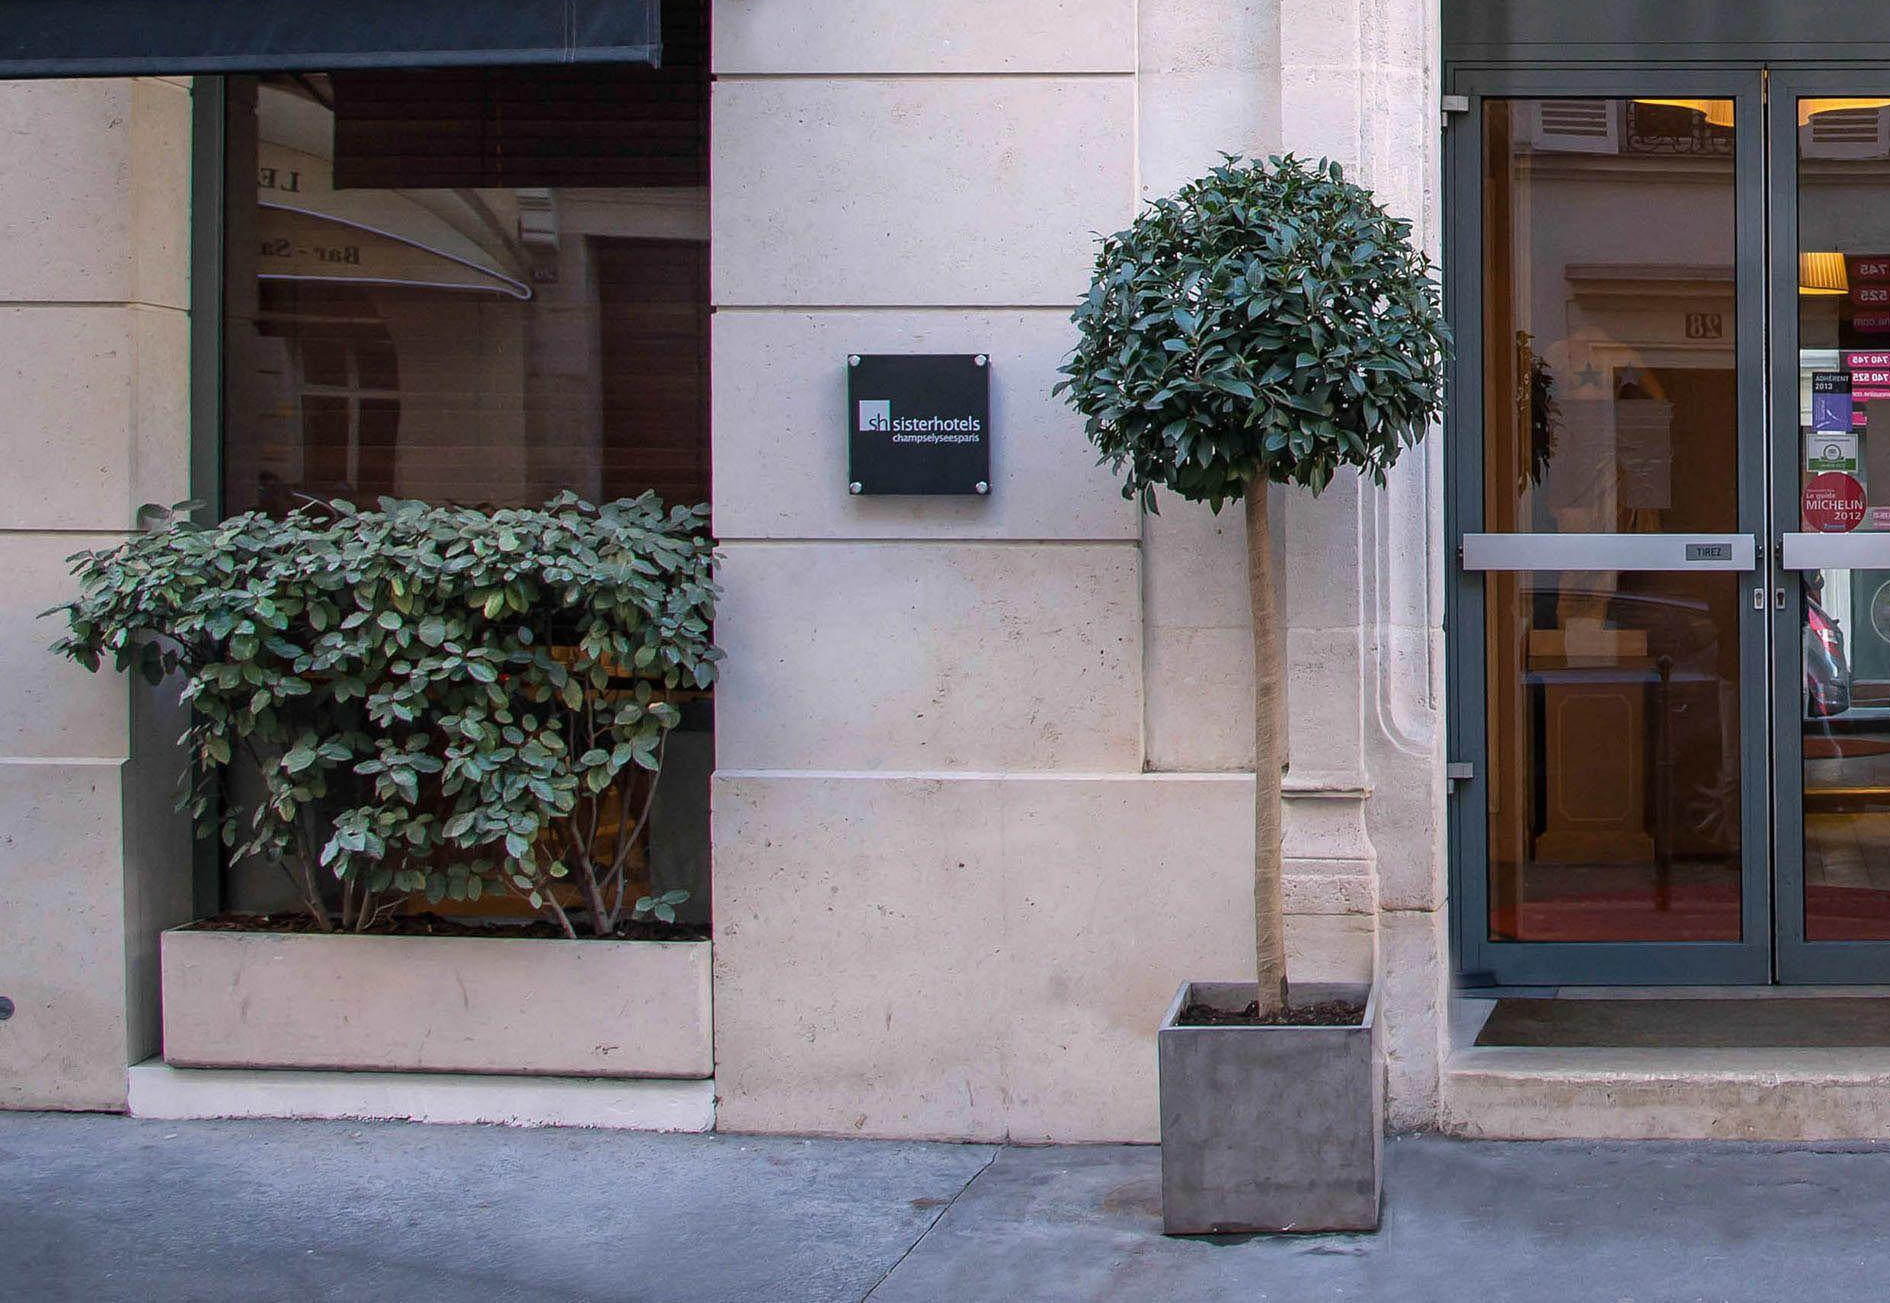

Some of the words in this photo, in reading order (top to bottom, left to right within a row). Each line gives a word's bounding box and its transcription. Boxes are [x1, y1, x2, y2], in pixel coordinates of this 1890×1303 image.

[869, 413, 888, 432] sh
[892, 416, 981, 431] sisterhotels
[892, 433, 980, 444] champselyseesparis
[1806, 500, 1863, 510] MICHELIN
[1834, 512, 1862, 520] 2012
[1697, 547, 1722, 557] TIREZ
